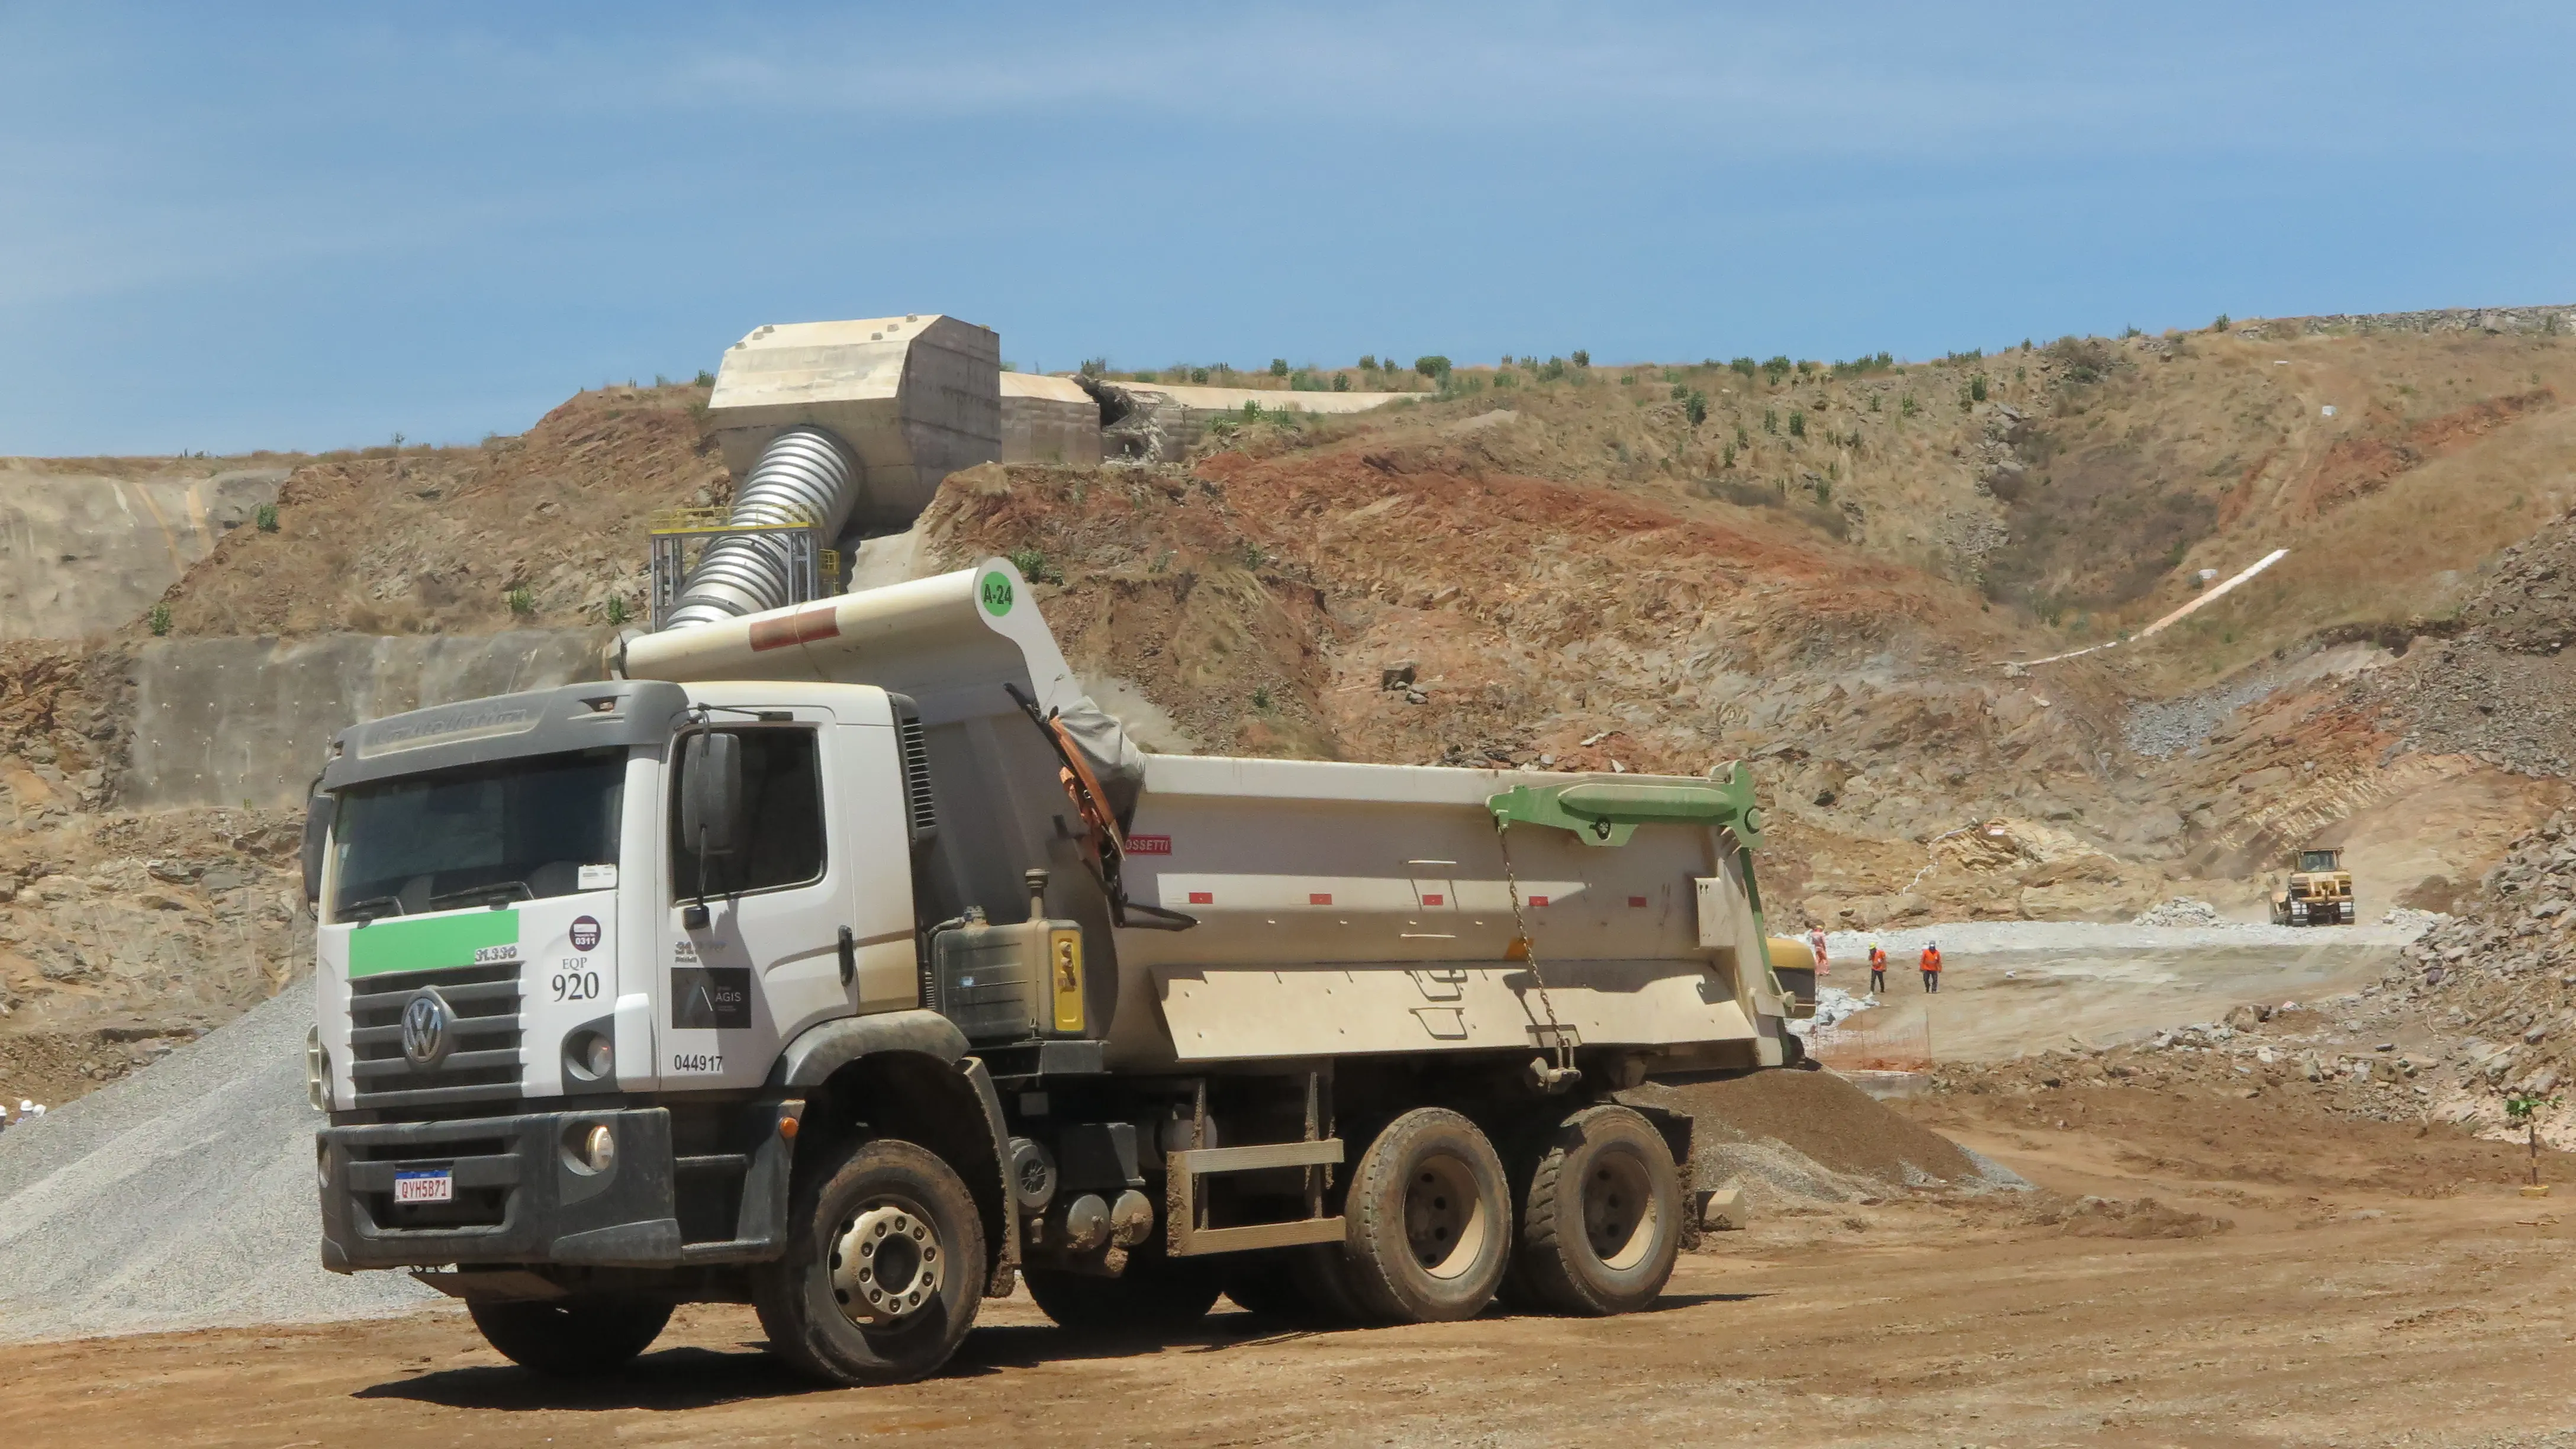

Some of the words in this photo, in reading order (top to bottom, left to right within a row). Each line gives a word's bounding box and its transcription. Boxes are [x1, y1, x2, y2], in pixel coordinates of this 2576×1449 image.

[983, 584, 1012, 604] A-24
[1125, 840, 1168, 850] OSSETTI
[562, 957, 587, 970] EQP
[552, 972, 599, 1002] 920
[715, 992, 741, 1002] AGIS
[674, 1054, 723, 1071] 044917
